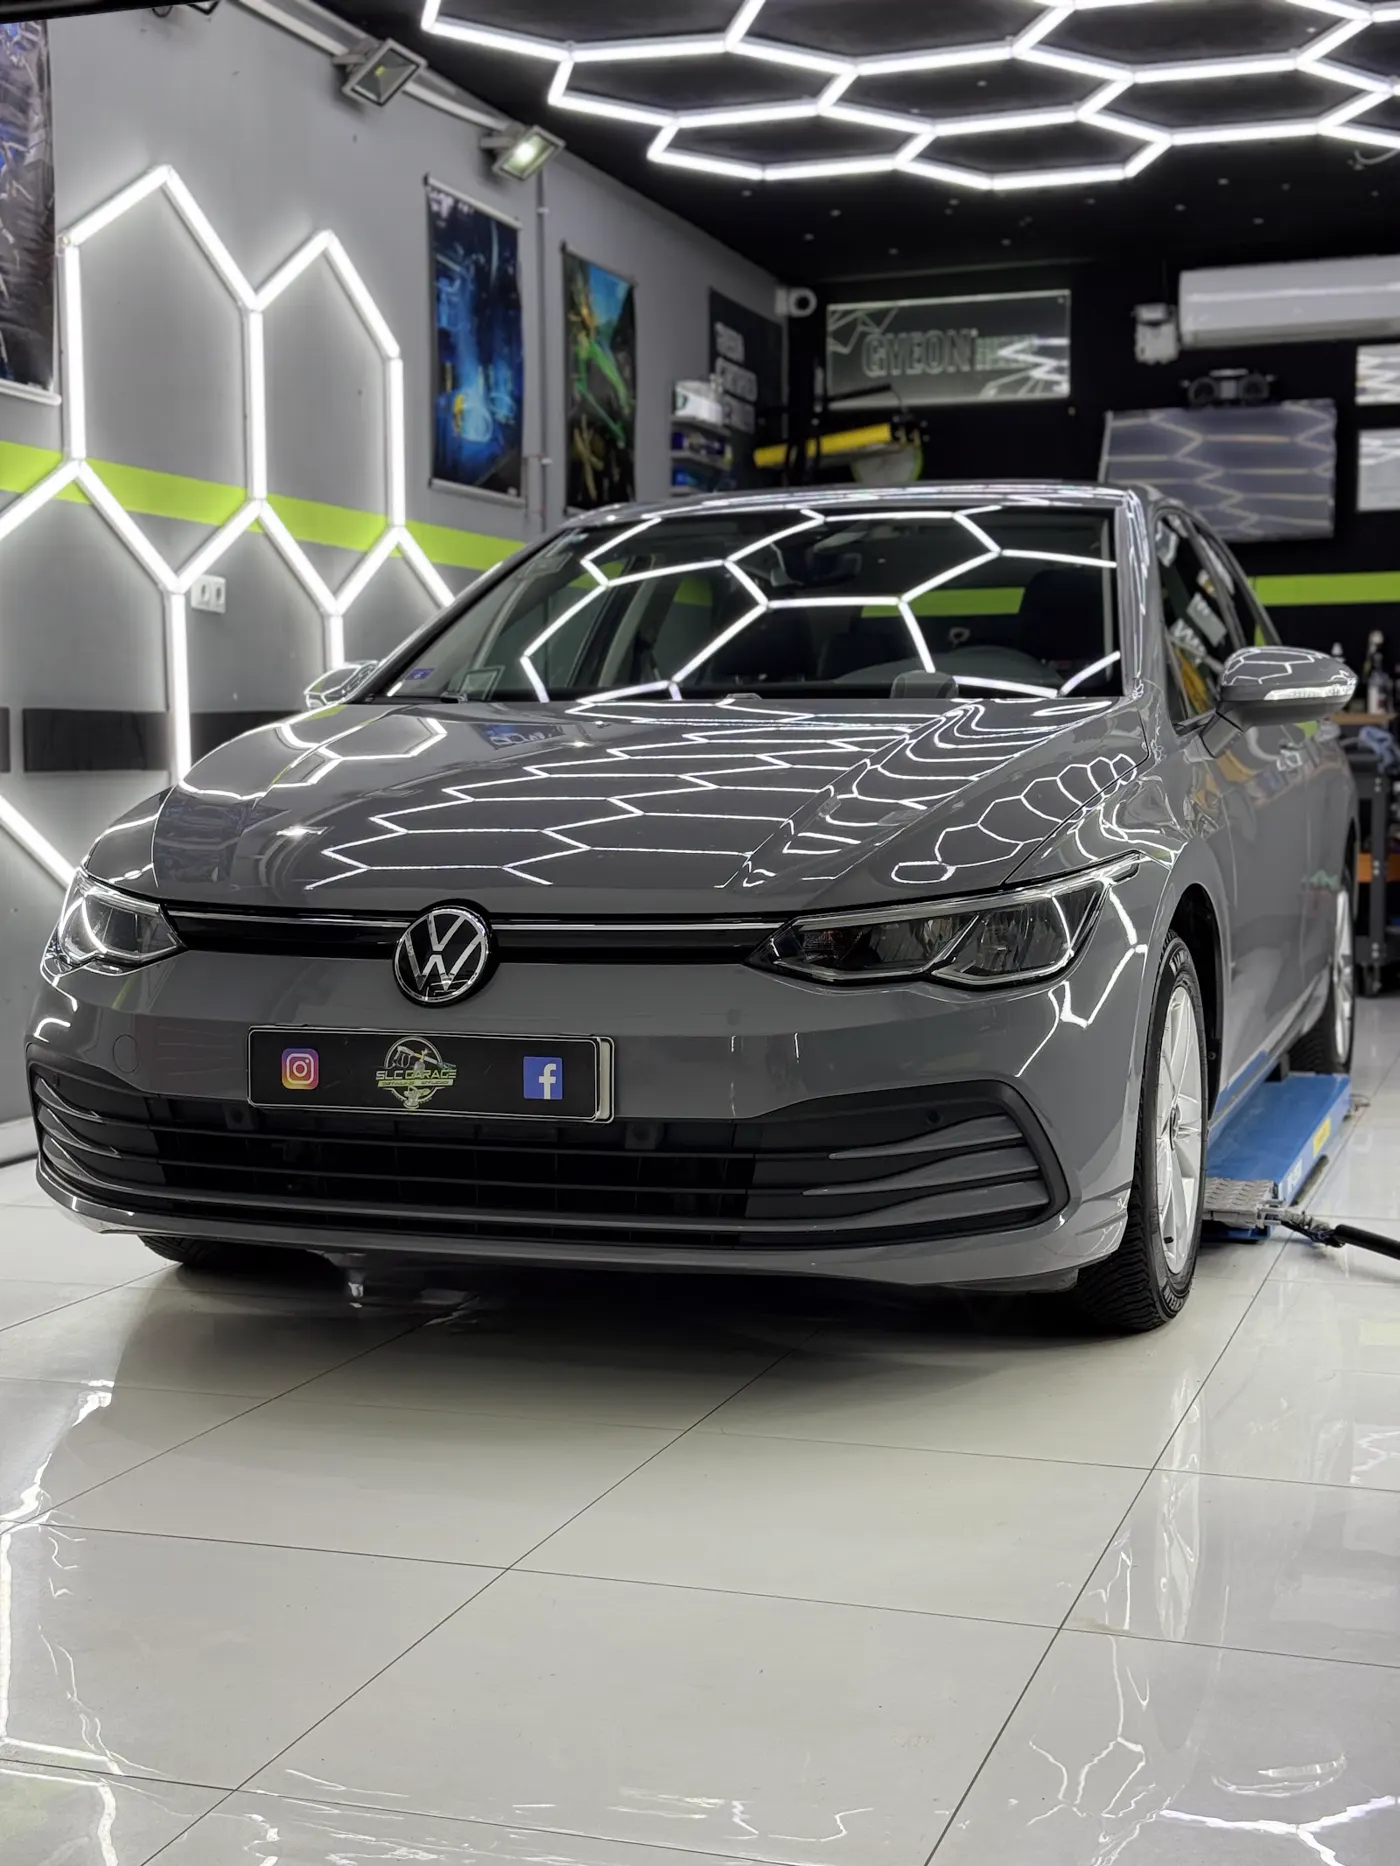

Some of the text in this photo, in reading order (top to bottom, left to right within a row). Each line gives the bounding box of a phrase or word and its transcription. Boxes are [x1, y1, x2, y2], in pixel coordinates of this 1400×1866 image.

[862, 328, 971, 378] GYEON
[375, 1069, 457, 1080] SLC GARAGE
